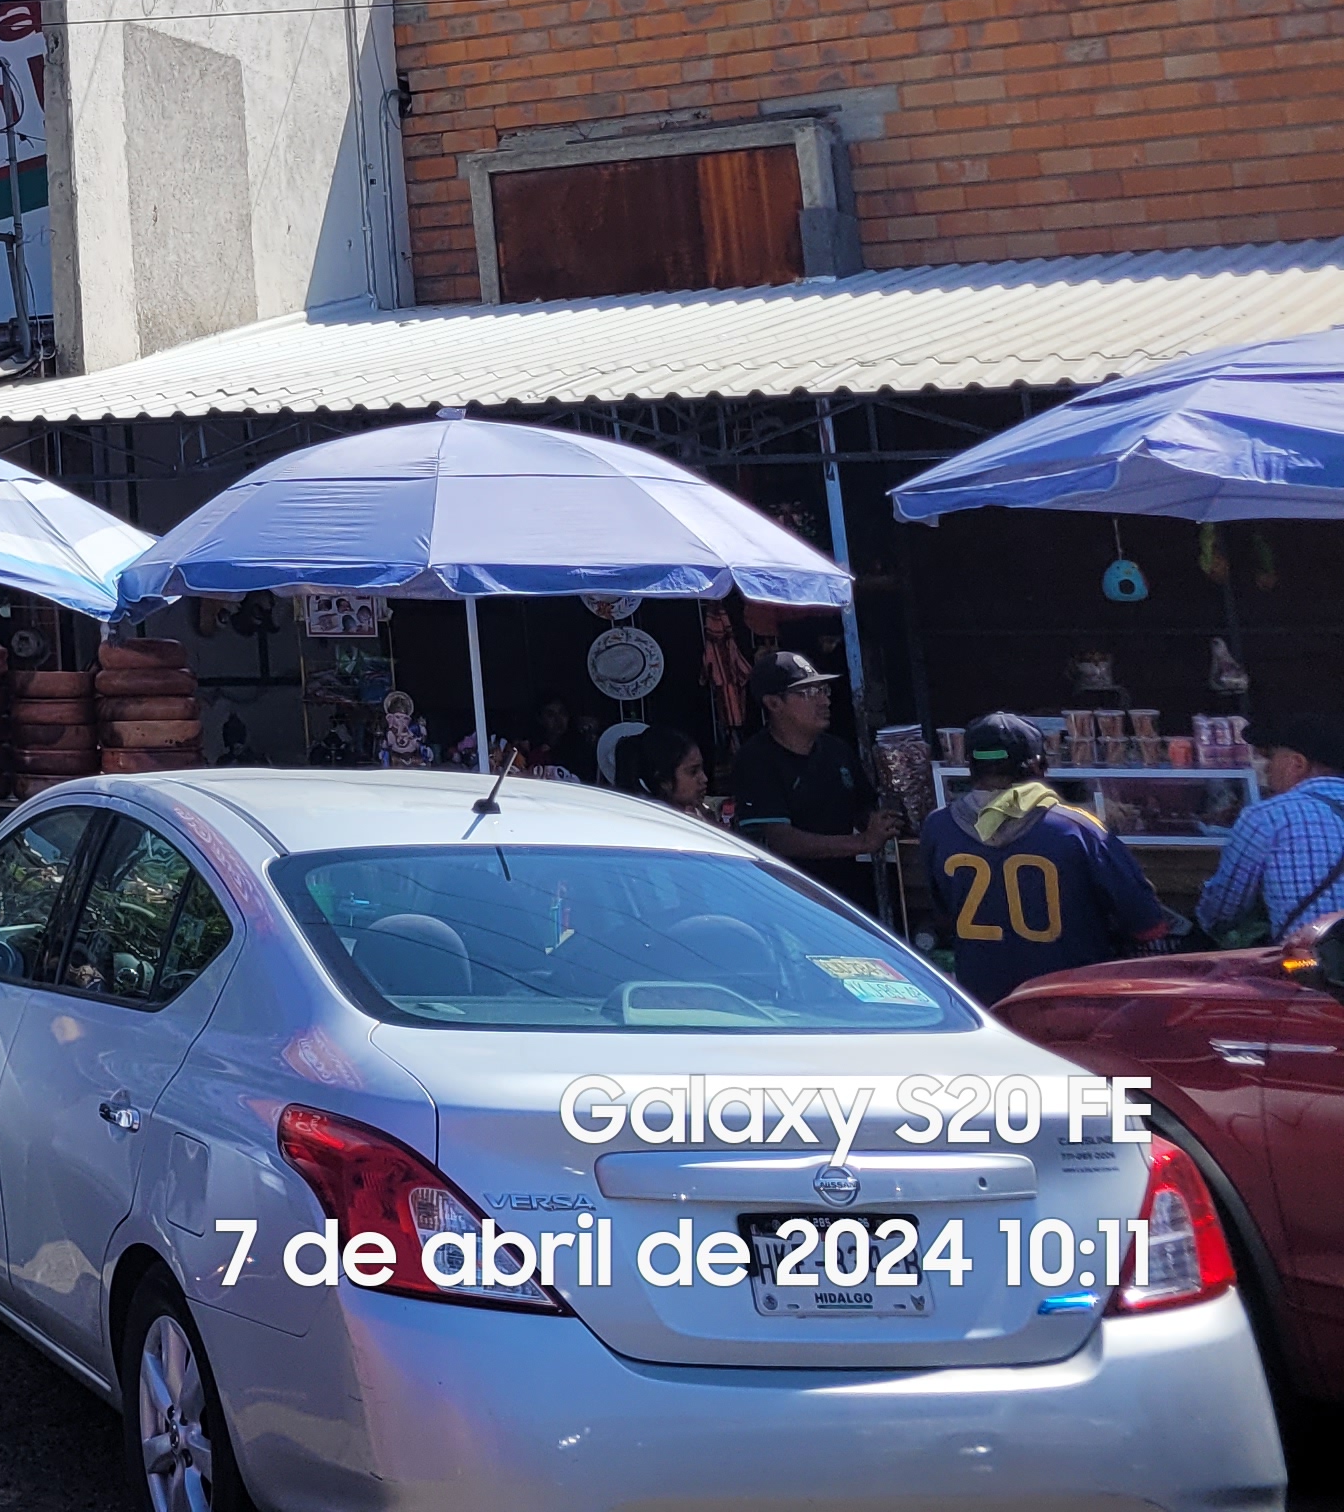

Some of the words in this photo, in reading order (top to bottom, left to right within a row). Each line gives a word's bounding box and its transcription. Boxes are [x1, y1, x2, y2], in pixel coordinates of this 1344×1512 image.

[944, 854, 1063, 943] 20
[483, 1193, 597, 1211] VERSA
[815, 1292, 873, 1304] HIDALGO
